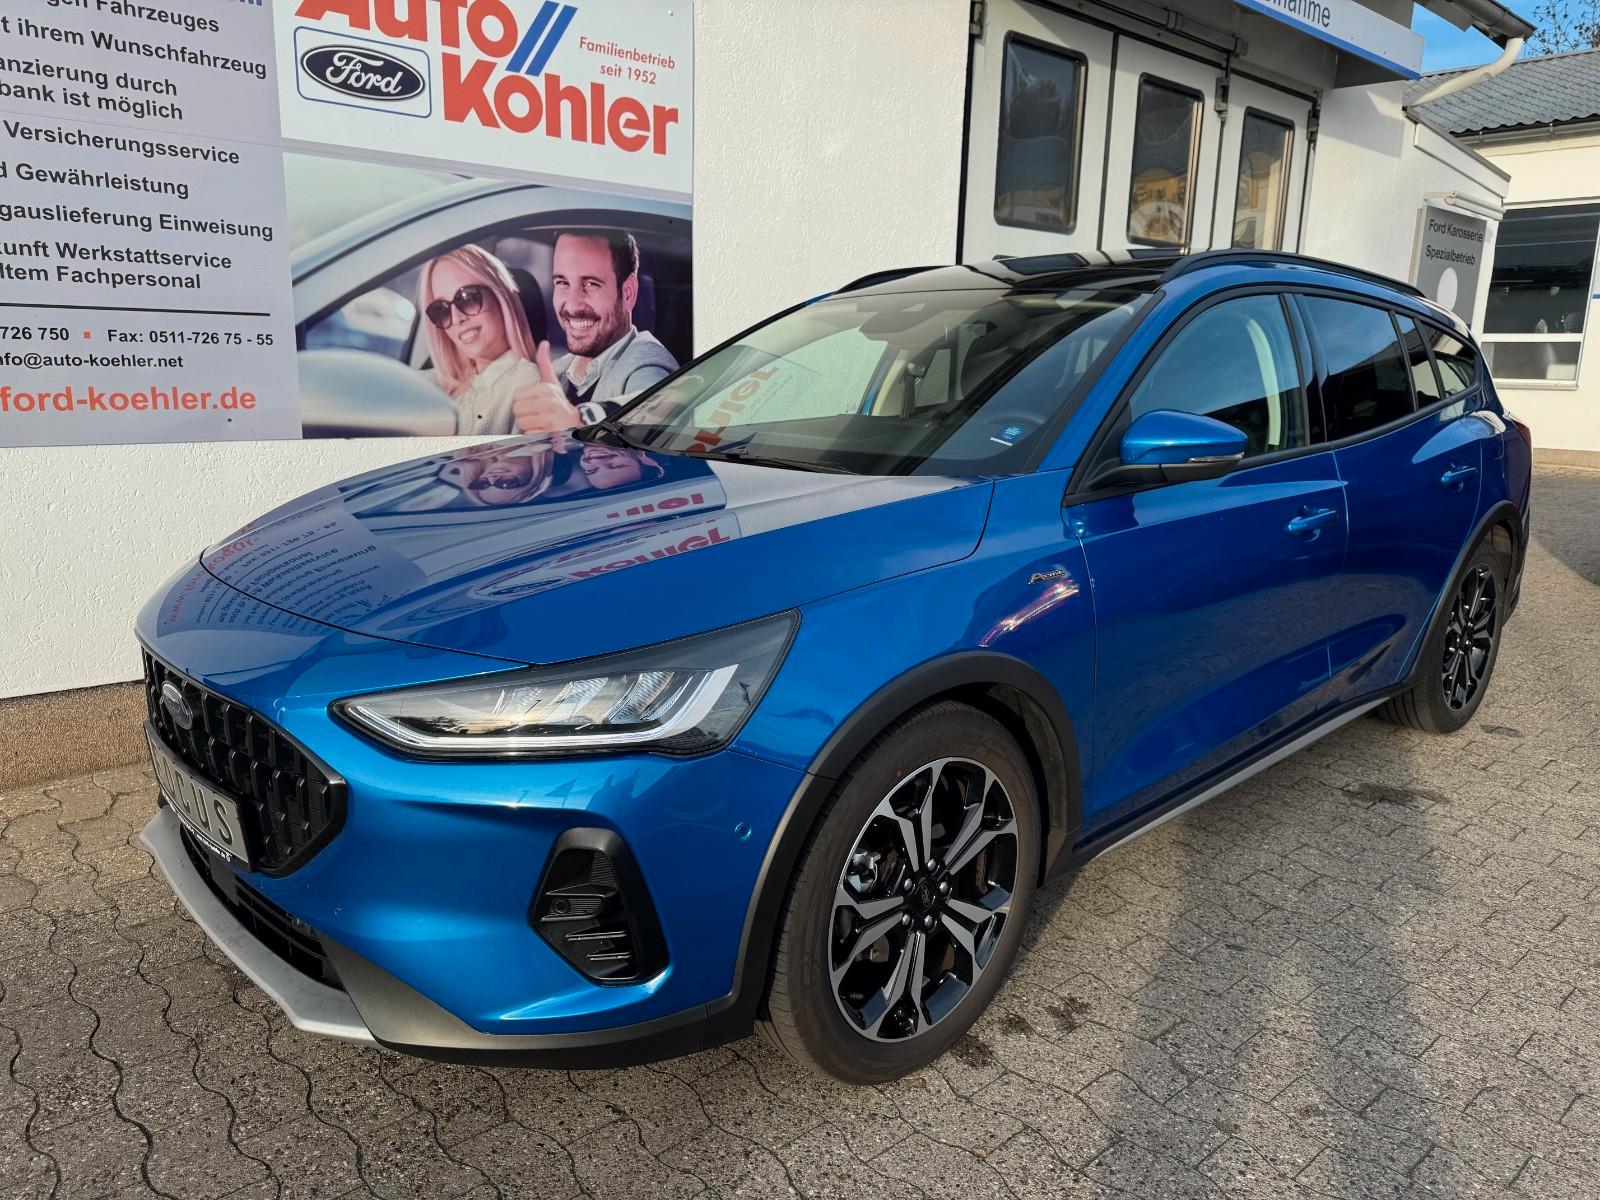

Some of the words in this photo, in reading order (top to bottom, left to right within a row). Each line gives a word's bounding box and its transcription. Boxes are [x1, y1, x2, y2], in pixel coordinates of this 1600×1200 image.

[18, 18, 84, 45] ihrem
[91, 30, 267, 79] Wunschfahrzeug
[579, 36, 677, 70] Familienbetrieb
[116, 72, 177, 96] durch
[325, 50, 403, 95] Ford
[600, 62, 622, 78] seit
[627, 66, 656, 85] 1952
[63, 88, 91, 108] ist
[97, 96, 183, 120] möglich
[3, 120, 240, 164] Versicherungsservice
[16, 163, 189, 200] Gewährleistung
[159, 213, 273, 241] Einweisung
[1429, 219, 1446, 234] Ford
[1447, 223, 1483, 242] Karosserie
[0, 240, 50, 258] unft
[55, 241, 232, 269] Werkstattservice
[1426, 244, 1476, 265] Spezialbetrieb
[57, 265, 201, 289] Fachpersonal
[38, 327, 70, 341] 750
[107, 329, 143, 343] Fax:
[149, 331, 220, 345] 0511-726
[224, 332, 242, 345] 75
[256, 333, 274, 346] 55
[0, 386, 257, 412] ford-koehler.de
